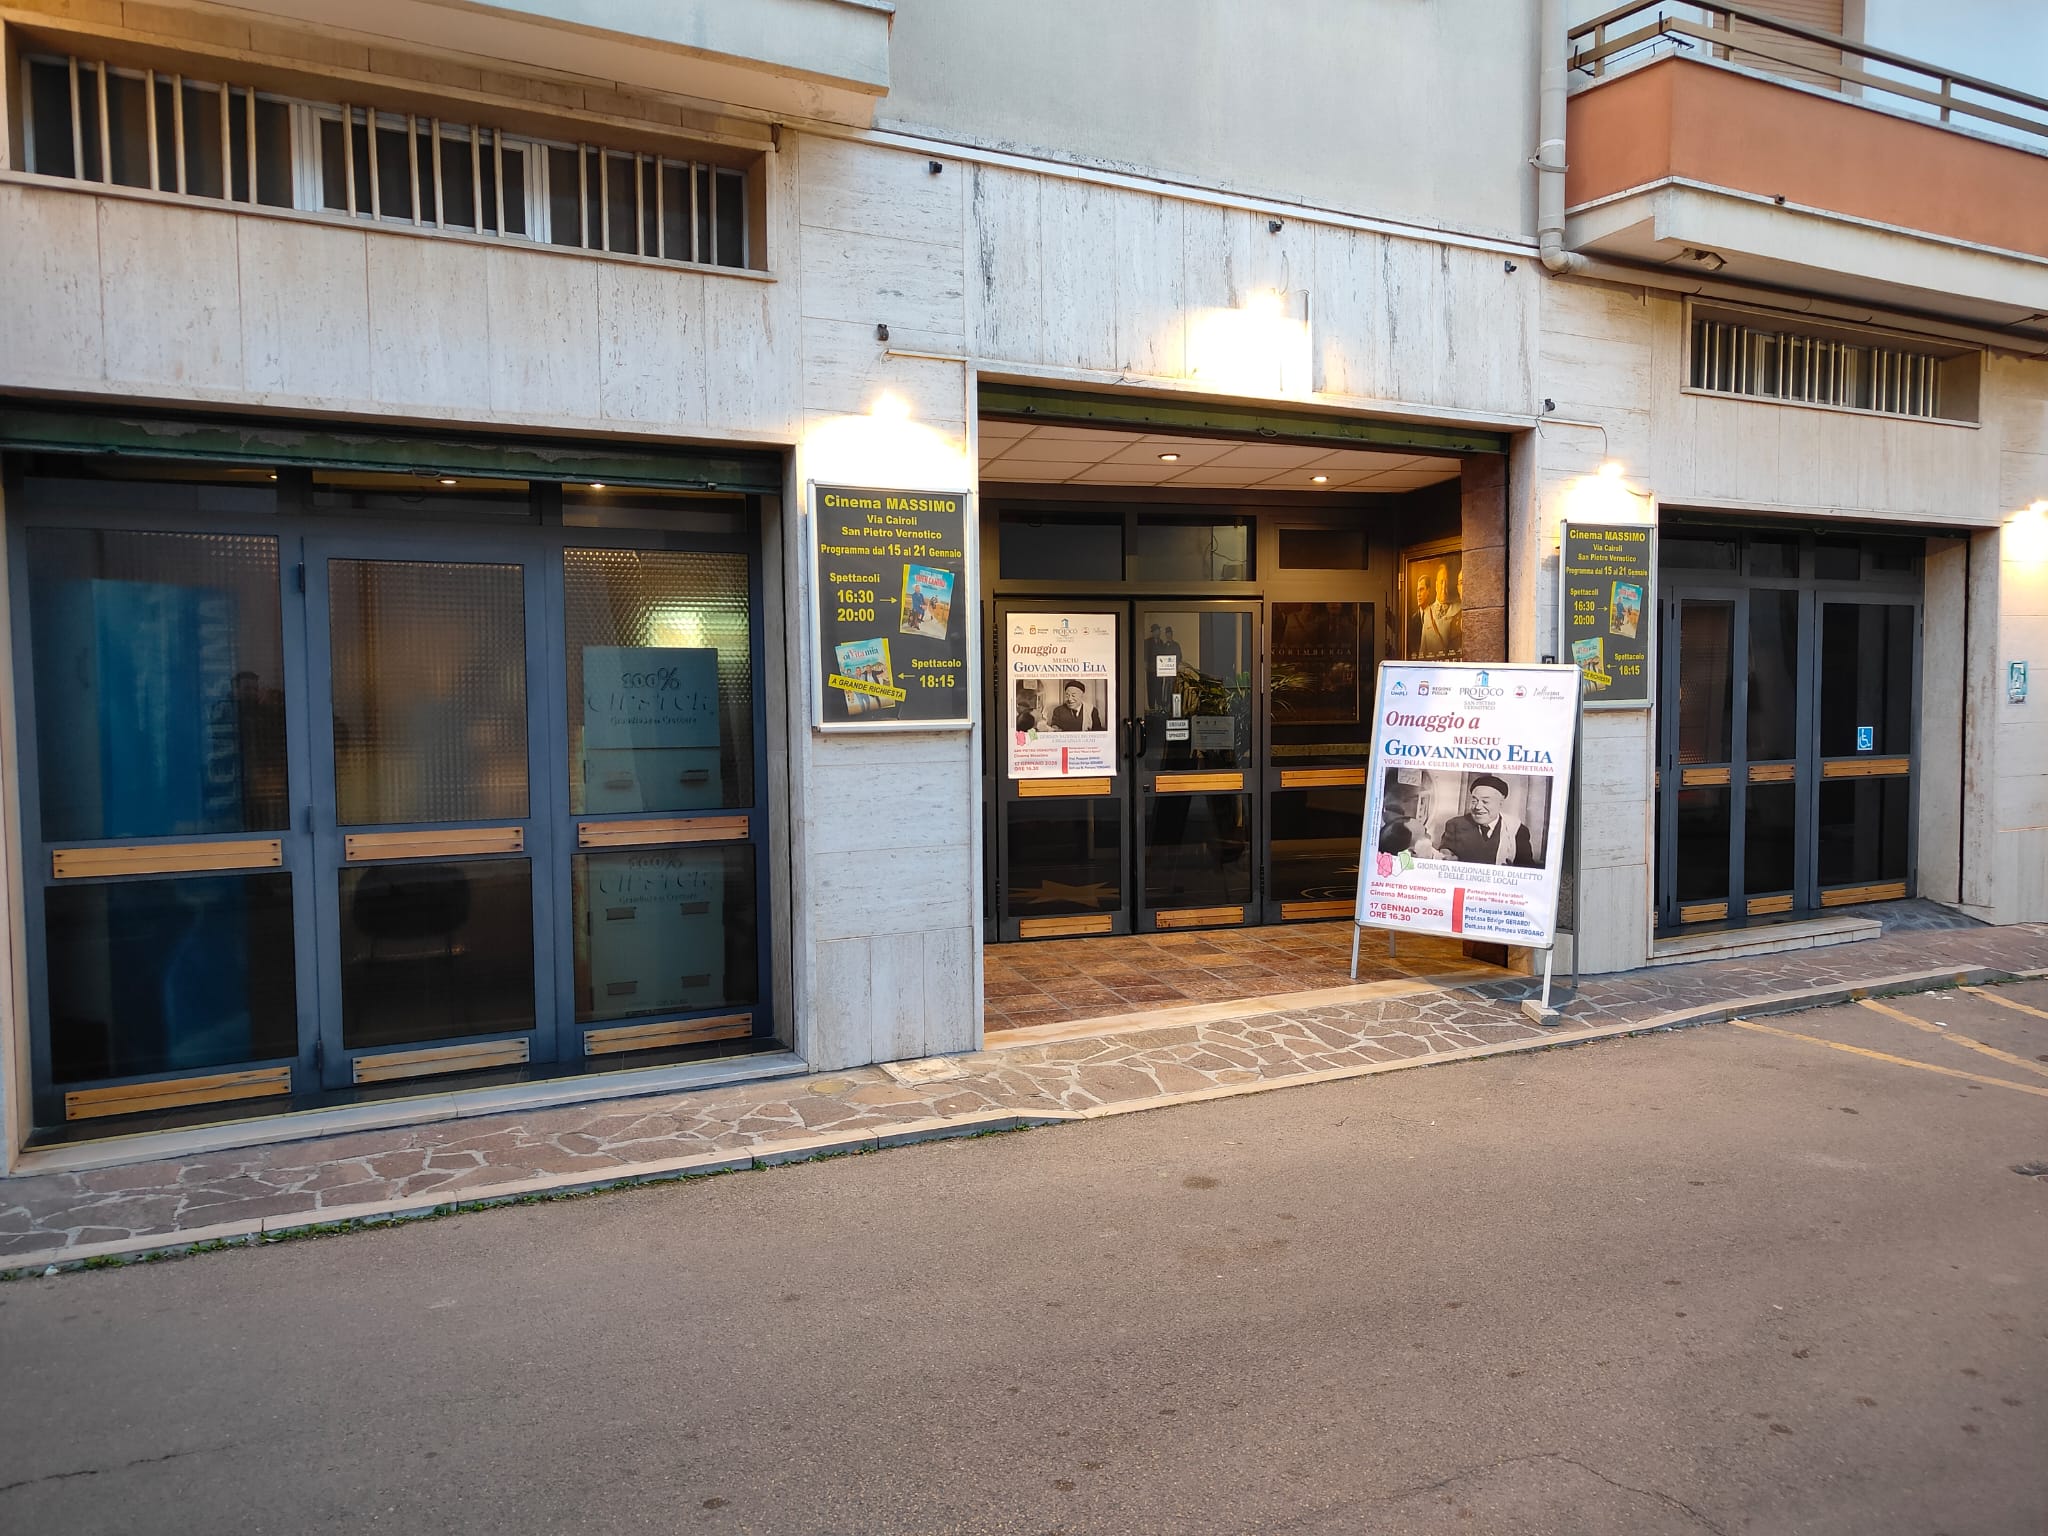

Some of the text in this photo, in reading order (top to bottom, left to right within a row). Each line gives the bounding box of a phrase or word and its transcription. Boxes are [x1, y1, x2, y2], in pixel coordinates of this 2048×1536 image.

[824, 494, 956, 513] Cinema MASSIMO
[867, 514, 918, 526] Via Cairoli
[841, 527, 942, 540] San Pietro Vernotico
[1569, 529, 1646, 542] Cinema MASSIMO
[820, 543, 962, 558] Programma dal 15 al 21 Gennaio
[1592, 543, 1603, 551] Via
[1590, 553, 1608, 561] Pietro
[1609, 554, 1637, 562] Vernotico
[1604, 565, 1612, 575] 15
[1618, 566, 1626, 576] 21
[829, 572, 880, 584] Spettacoli
[837, 589, 874, 603] 16:30
[1569, 587, 1599, 597] Spettacoli
[1574, 600, 1595, 611] 16:30
[837, 608, 875, 622] 20:00
[1573, 615, 1595, 625] 20:00
[1012, 643, 1067, 656] Omaggio a
[1614, 652, 1645, 662] Spettacolo
[911, 658, 962, 669] Spettacolo
[1013, 661, 1107, 673] GIOVANNINO ELIA
[1619, 664, 1641, 676] 18:15
[919, 674, 955, 688] 18:15
[838, 679, 868, 691] GRANDE
[869, 685, 903, 699] RICHIESTA
[1385, 710, 1481, 732] Omaggio a
[1453, 736, 1501, 746] MESCIU
[1384, 738, 1553, 764] GIOVANNINO ELIA
[1428, 760, 1460, 768] CULTURA
[1462, 762, 1499, 770] POPOLARE
[1502, 764, 1554, 773] SAMPIETRANA
[1417, 862, 1543, 881] GIORNATA NAZIONALE DEL DIALETTO
[1465, 874, 1492, 883] LINGUE
[1493, 877, 1518, 886] LOCALI
[1385, 882, 1408, 890] PIETRO
[1409, 885, 1447, 894] VERNOTICO
[1369, 889, 1428, 901] Cinema Massimo
[1369, 902, 1444, 917] 17 GENNAIO 2026
[1478, 907, 1503, 916] Pasquale
[1369, 910, 1411, 922] ORE 16.30
